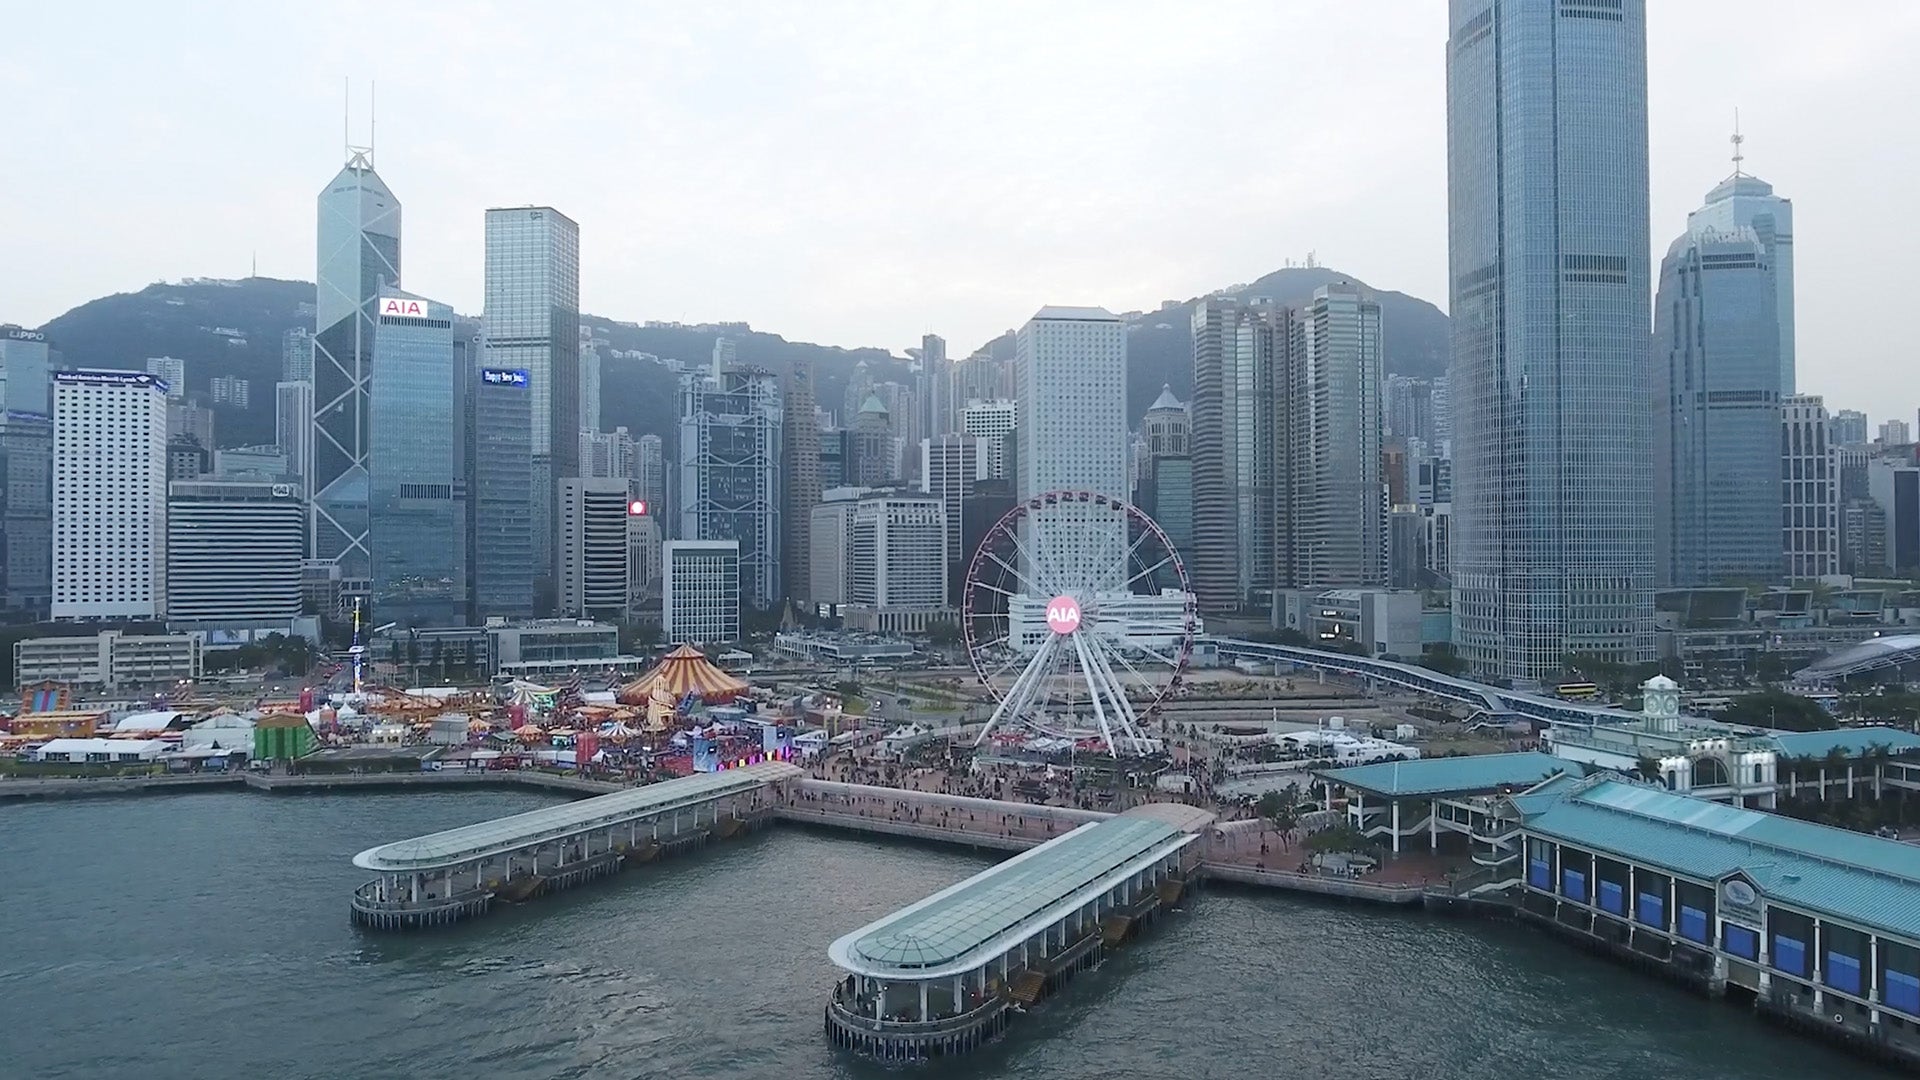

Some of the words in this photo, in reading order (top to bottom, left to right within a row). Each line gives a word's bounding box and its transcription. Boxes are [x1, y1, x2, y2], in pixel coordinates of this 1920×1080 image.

[386, 300, 421, 315] AIA
[9, 330, 45, 341] LIPPO
[1047, 607, 1079, 622] AIA
